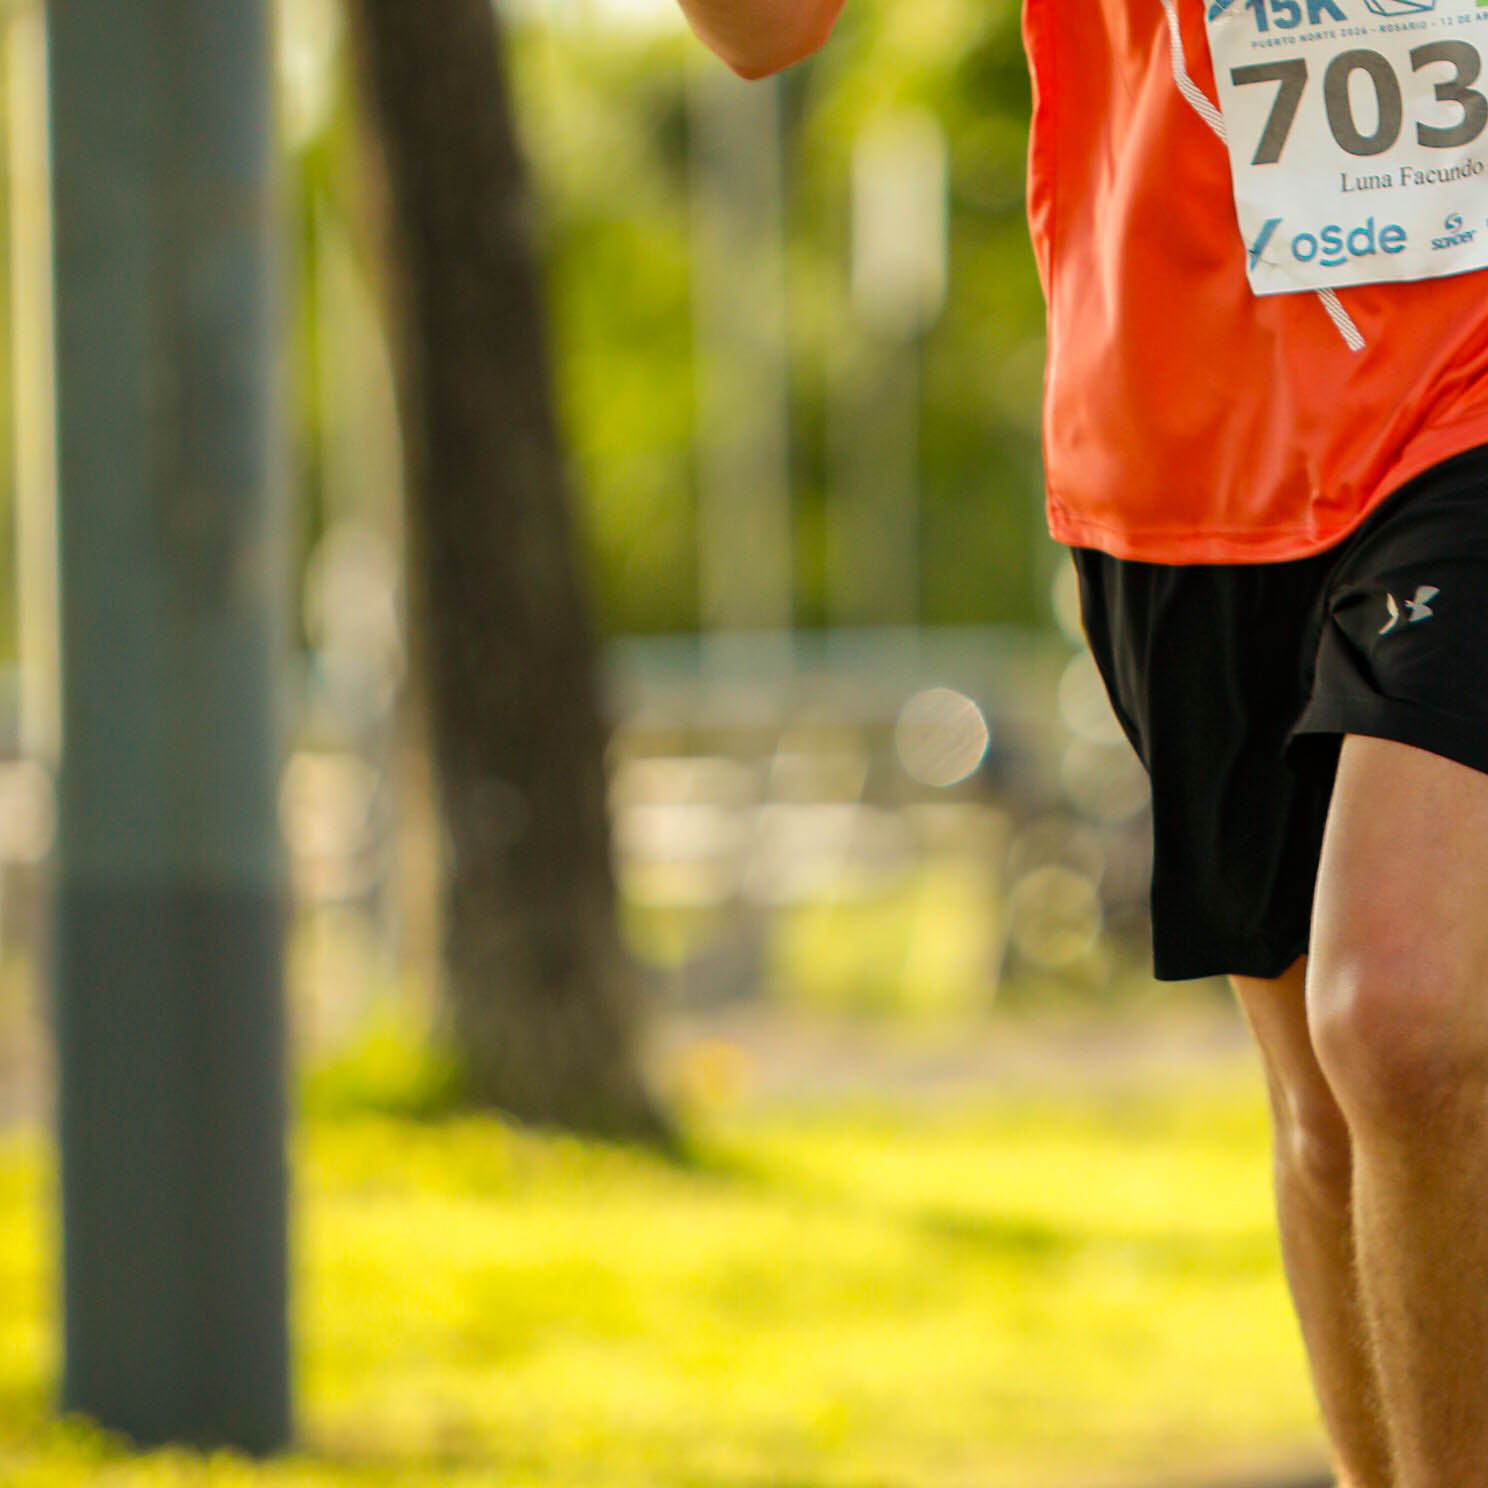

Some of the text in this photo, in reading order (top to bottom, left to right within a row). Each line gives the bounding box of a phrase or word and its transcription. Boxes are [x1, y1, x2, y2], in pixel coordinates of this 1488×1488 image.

[1251, 35, 1296, 48] PUERTO
[1299, 29, 1336, 42] NORTE
[1379, 20, 1427, 33] ROSARIO
[1458, 13, 1472, 24] DE
[1340, 158, 1485, 193] Luna Facundo
[1291, 216, 1407, 266] osde
